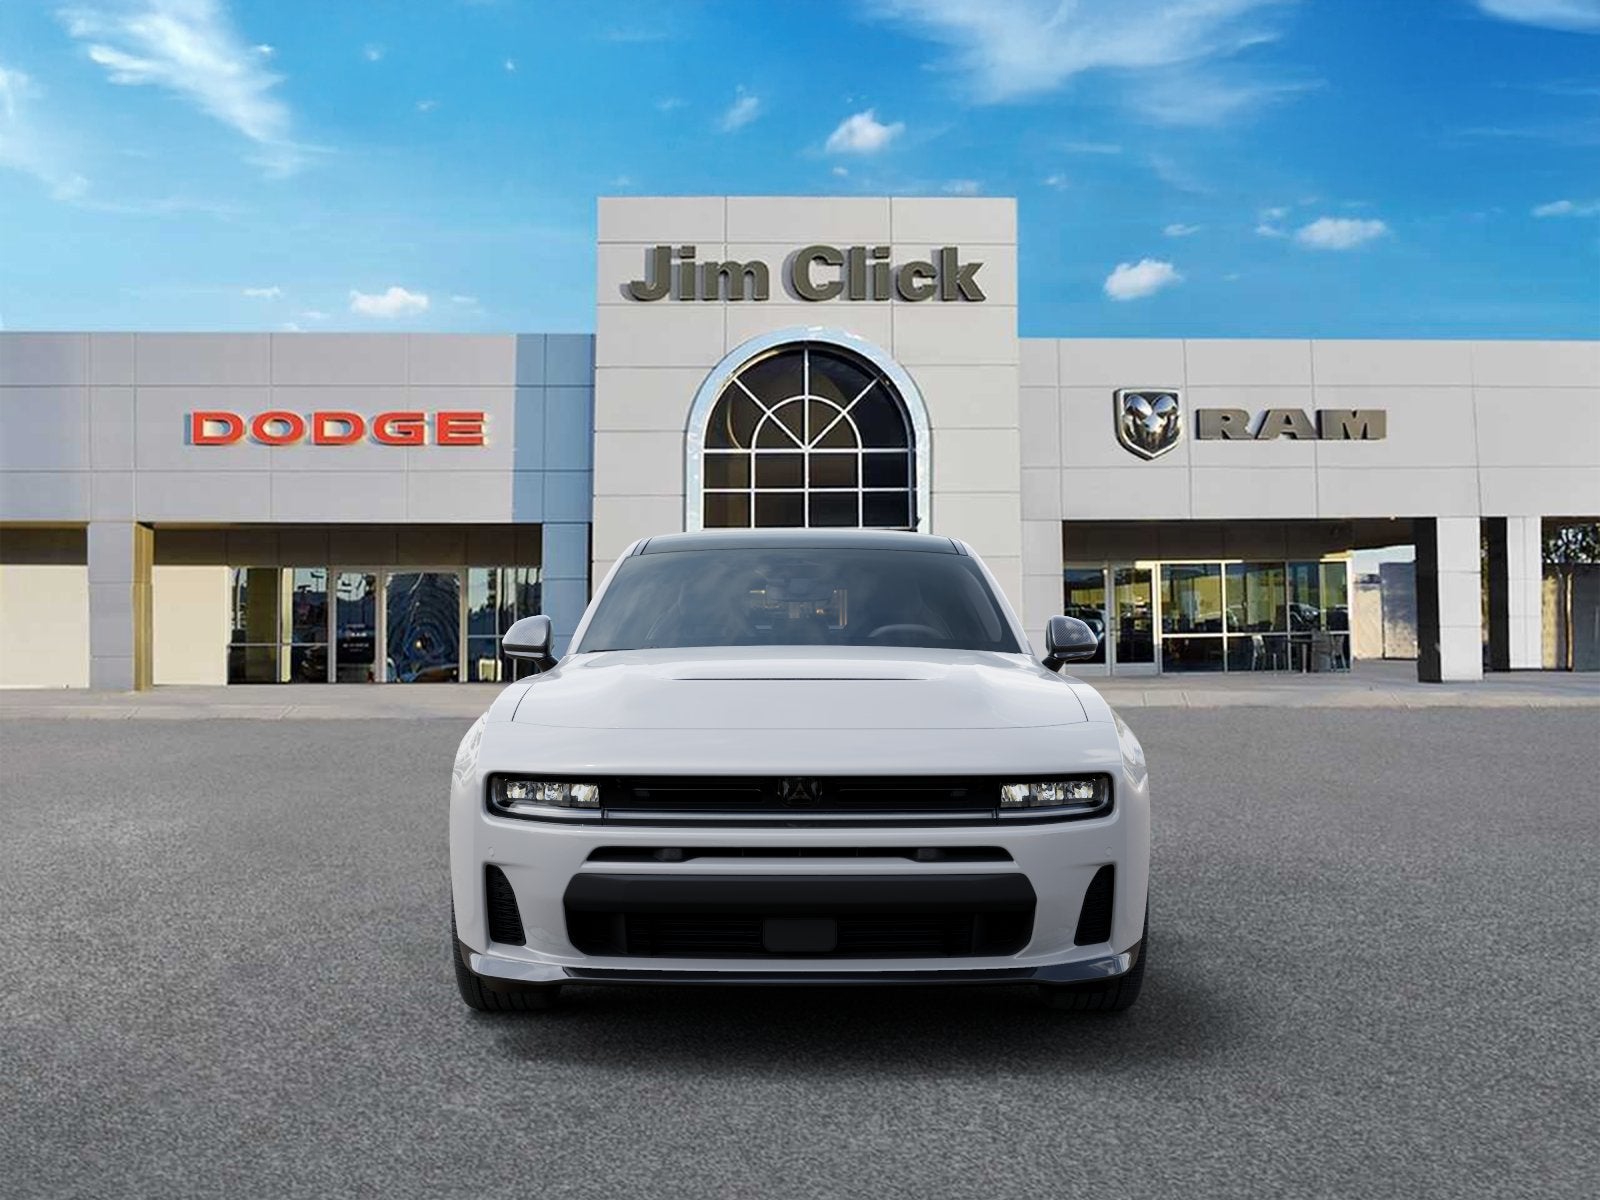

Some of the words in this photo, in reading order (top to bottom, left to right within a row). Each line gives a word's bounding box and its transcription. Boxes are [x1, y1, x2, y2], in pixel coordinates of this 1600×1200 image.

[627, 245, 770, 301] Jim
[790, 245, 987, 302] Click
[191, 410, 486, 446] DODGE
[1197, 408, 1387, 440] RAM
